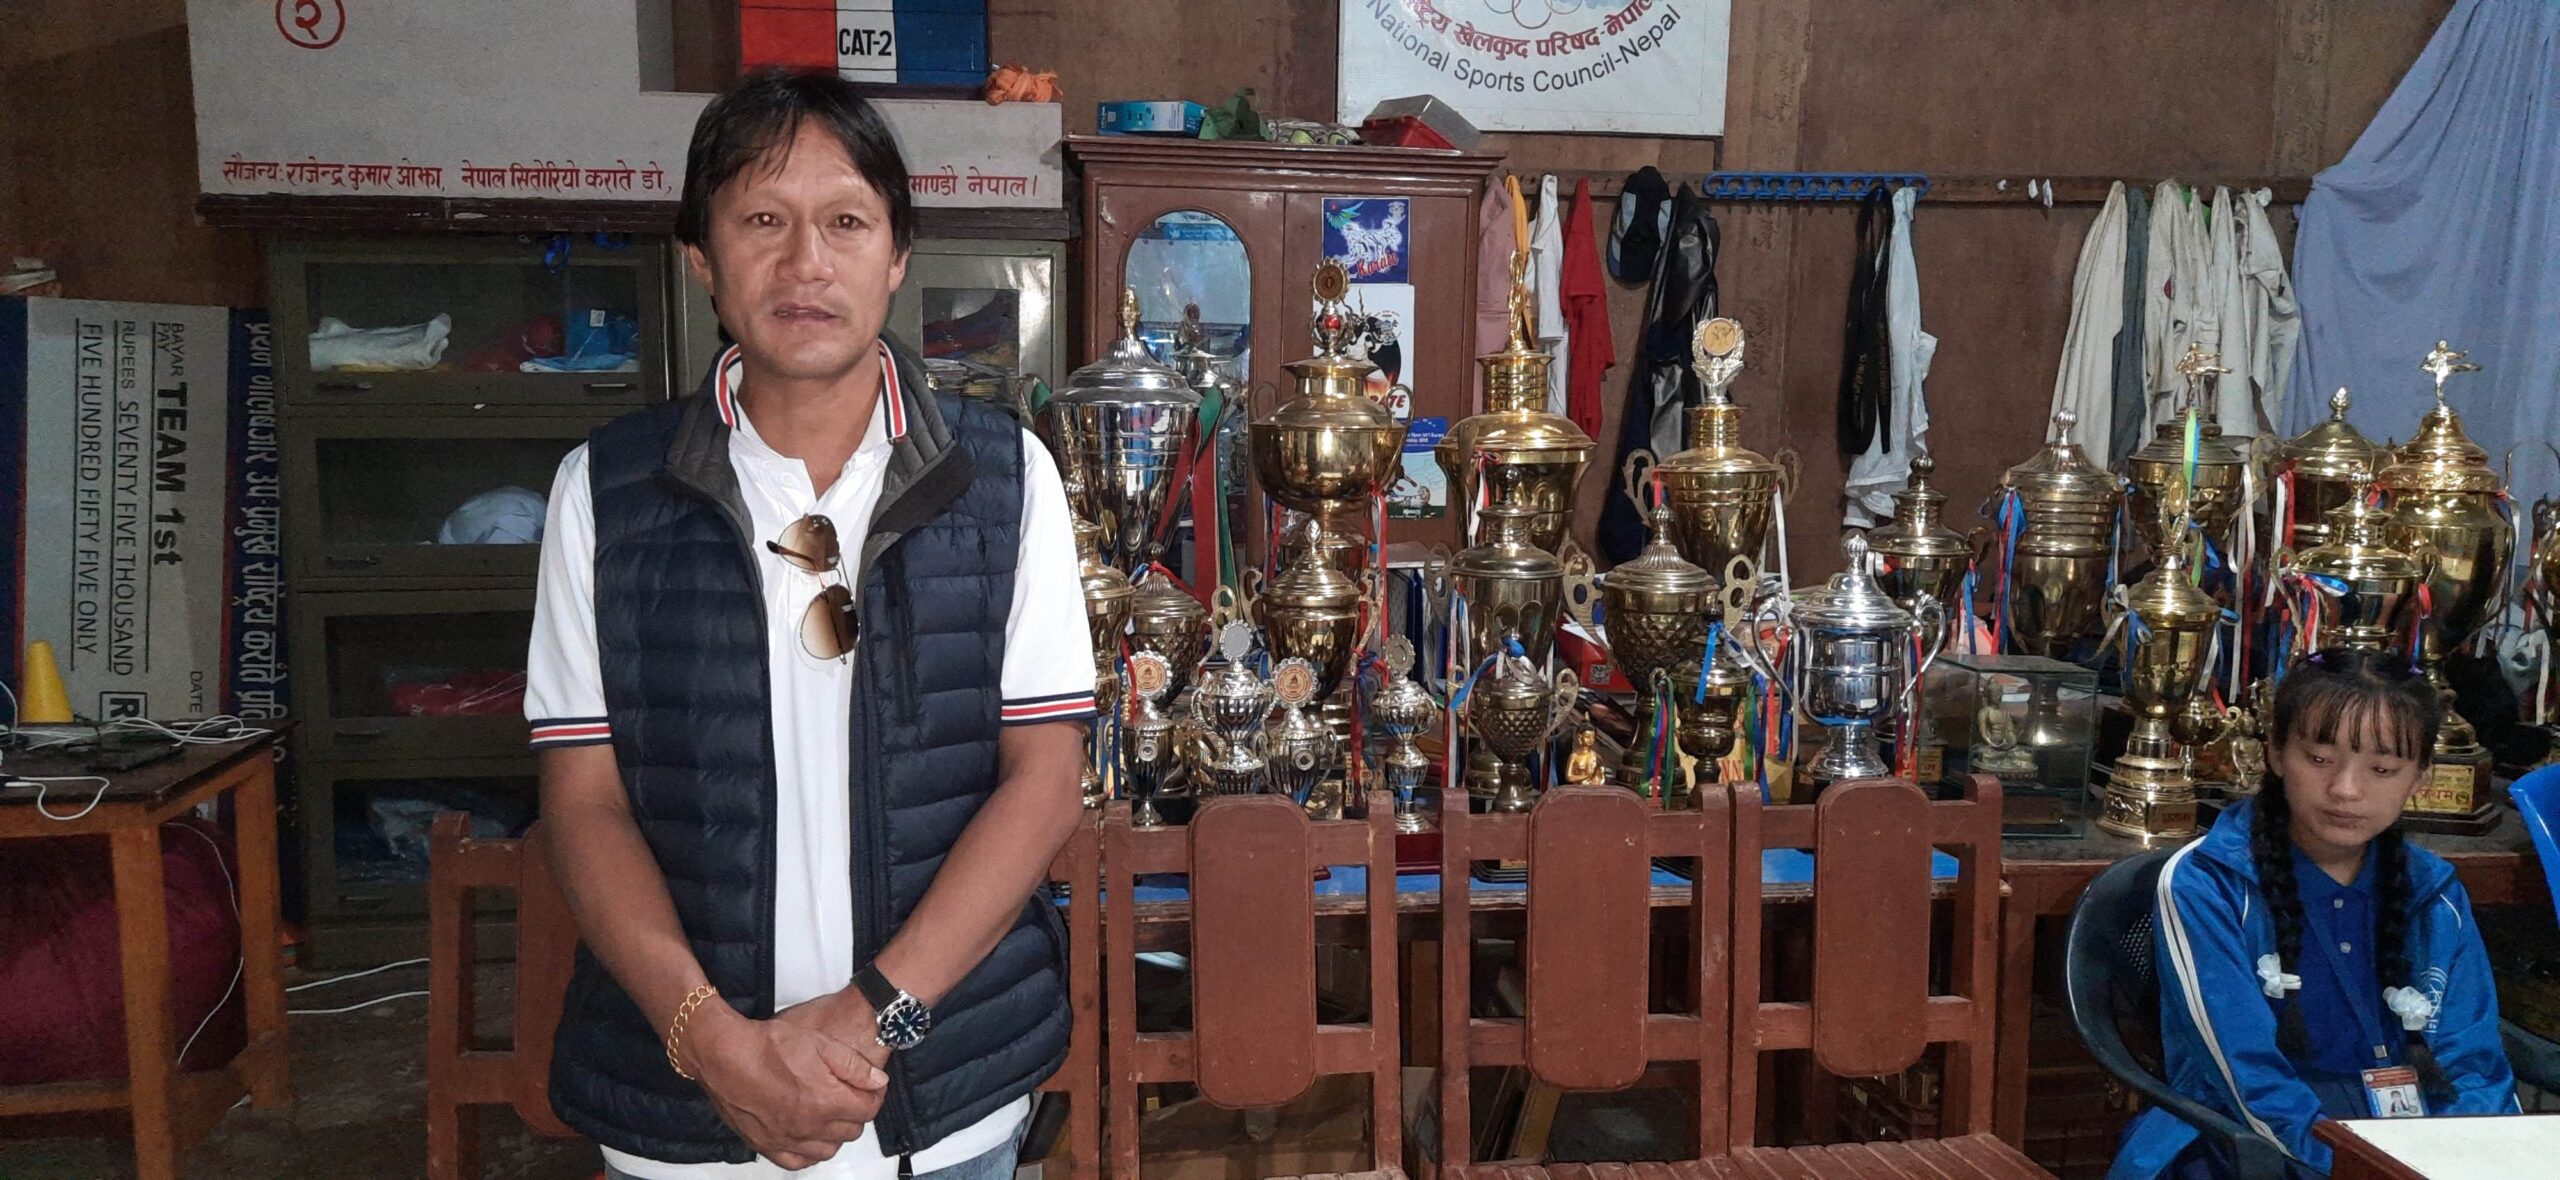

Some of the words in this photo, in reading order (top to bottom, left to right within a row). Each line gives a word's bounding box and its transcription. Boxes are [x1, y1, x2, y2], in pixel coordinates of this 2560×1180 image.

[839, 28, 892, 56] CAT-2
[1366, 0, 1450, 72] National
[1454, 58, 1525, 92] Sports
[1533, 4, 1681, 92] Council-Nepal
[286, 156, 346, 187] राजेन्द्र
[348, 164, 393, 190] कुमार
[461, 160, 507, 189] नेपाल
[585, 160, 636, 191] कराते
[909, 165, 958, 196] माण्डौ
[82, 323, 103, 368] FIVE
[121, 321, 136, 389] RUPEES
[157, 322, 171, 353] PAY
[170, 323, 184, 377] BAYAR
[80, 376, 101, 481] HUNDRED
[117, 401, 139, 496] SEVENTY
[155, 382, 188, 492] TEAM
[79, 489, 99, 543] FIFTY
[116, 503, 137, 547] FIVE
[154, 507, 185, 566] 1st
[78, 550, 99, 593] FIVE
[76, 601, 98, 654] ONLY
[113, 554, 136, 676] THOUSAND
[190, 671, 203, 713] DATE
